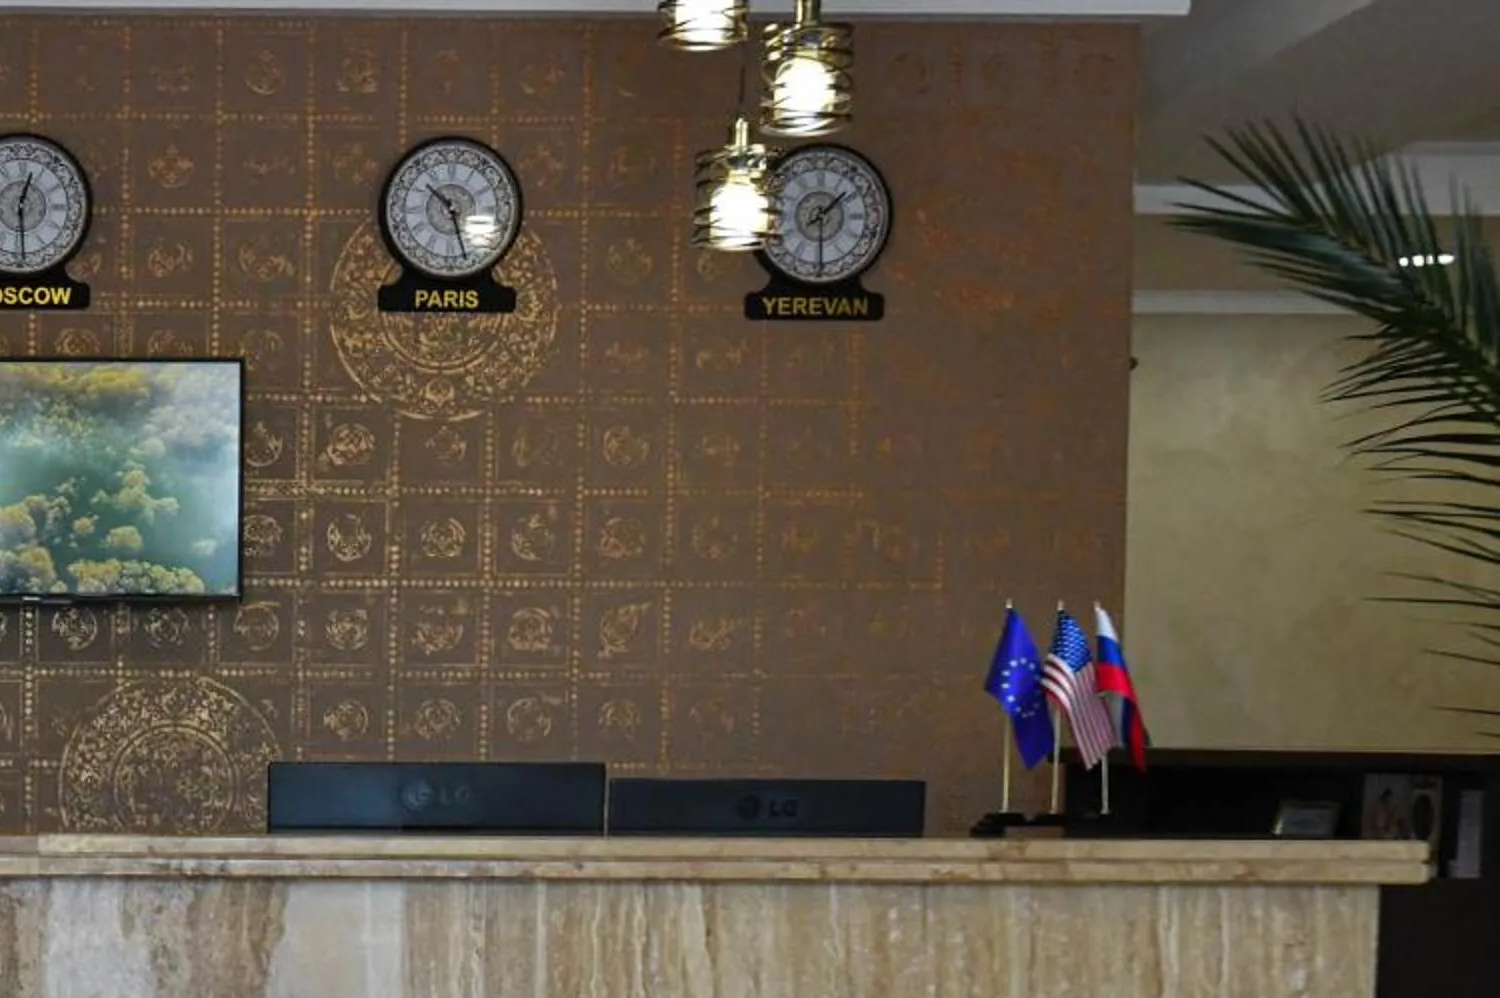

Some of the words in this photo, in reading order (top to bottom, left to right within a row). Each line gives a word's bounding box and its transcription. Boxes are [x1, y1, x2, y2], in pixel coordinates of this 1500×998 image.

[415, 289, 479, 308] PARIS
[762, 297, 868, 316] YEREVAN
[439, 786, 469, 804] LG
[767, 798, 798, 816] LG
